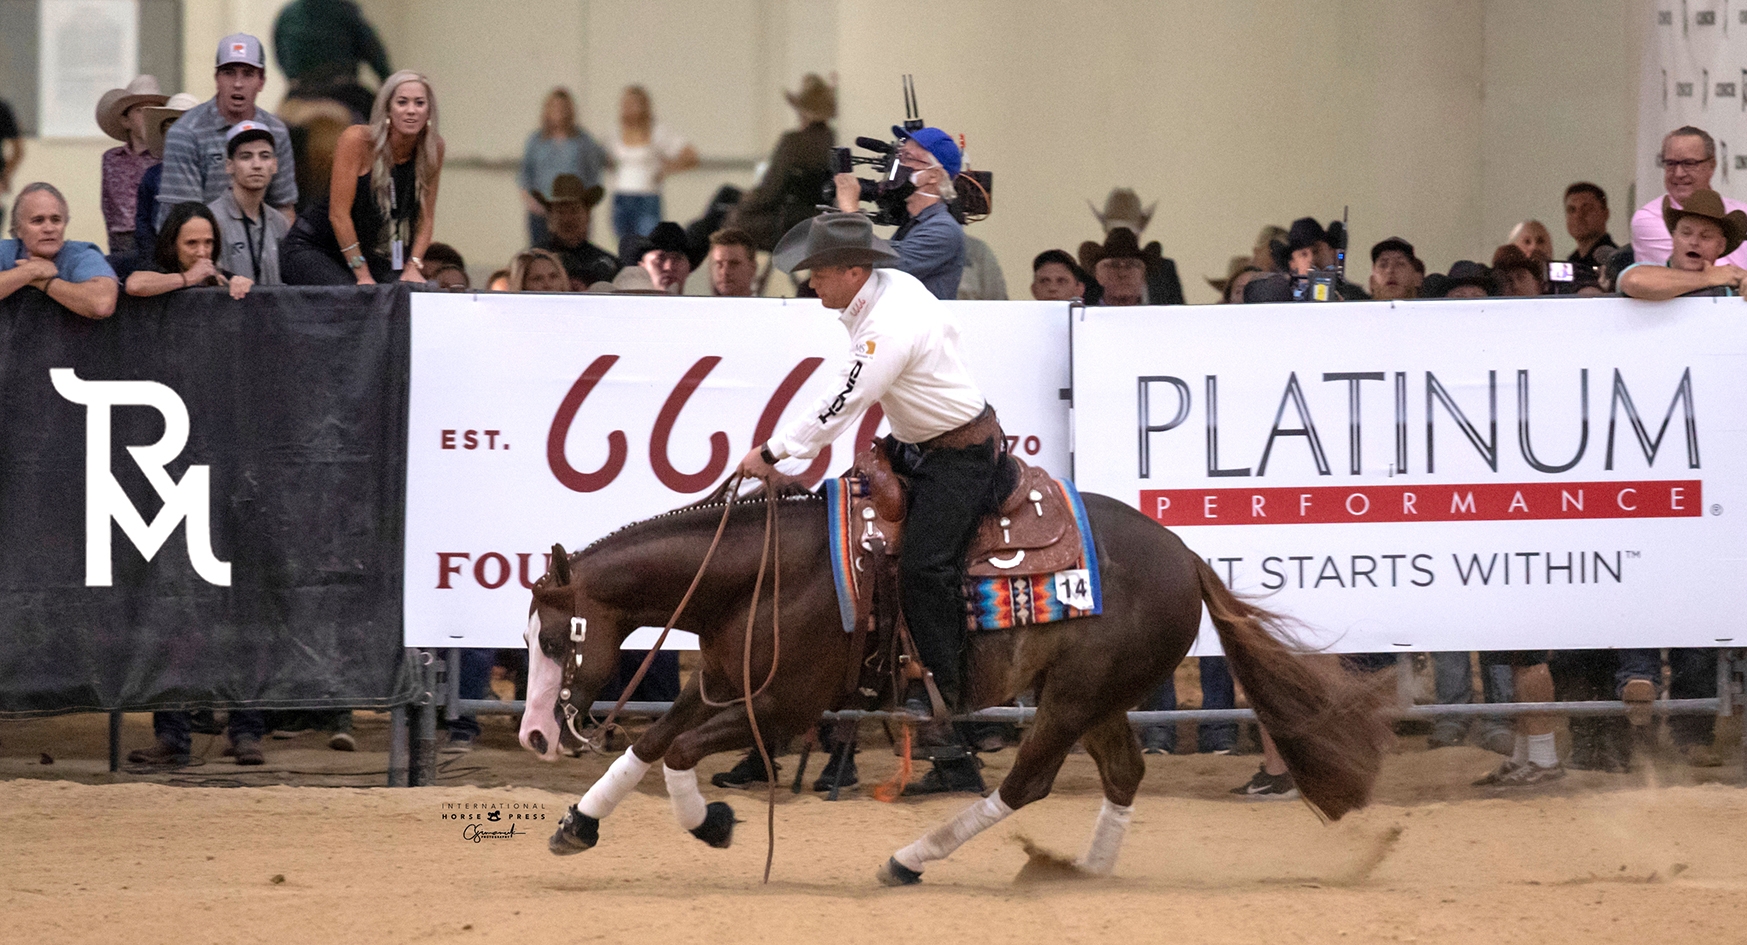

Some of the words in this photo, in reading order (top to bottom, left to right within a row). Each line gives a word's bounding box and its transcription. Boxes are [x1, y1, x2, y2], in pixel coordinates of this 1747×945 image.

[818, 360, 863, 424] CINCH
[1138, 366, 1701, 479] PLATINUM
[441, 429, 510, 451] EST.
[1156, 487, 1685, 519] PERFORMANCE
[1060, 578, 1087, 599] 14
[1261, 553, 1434, 590] STARTS
